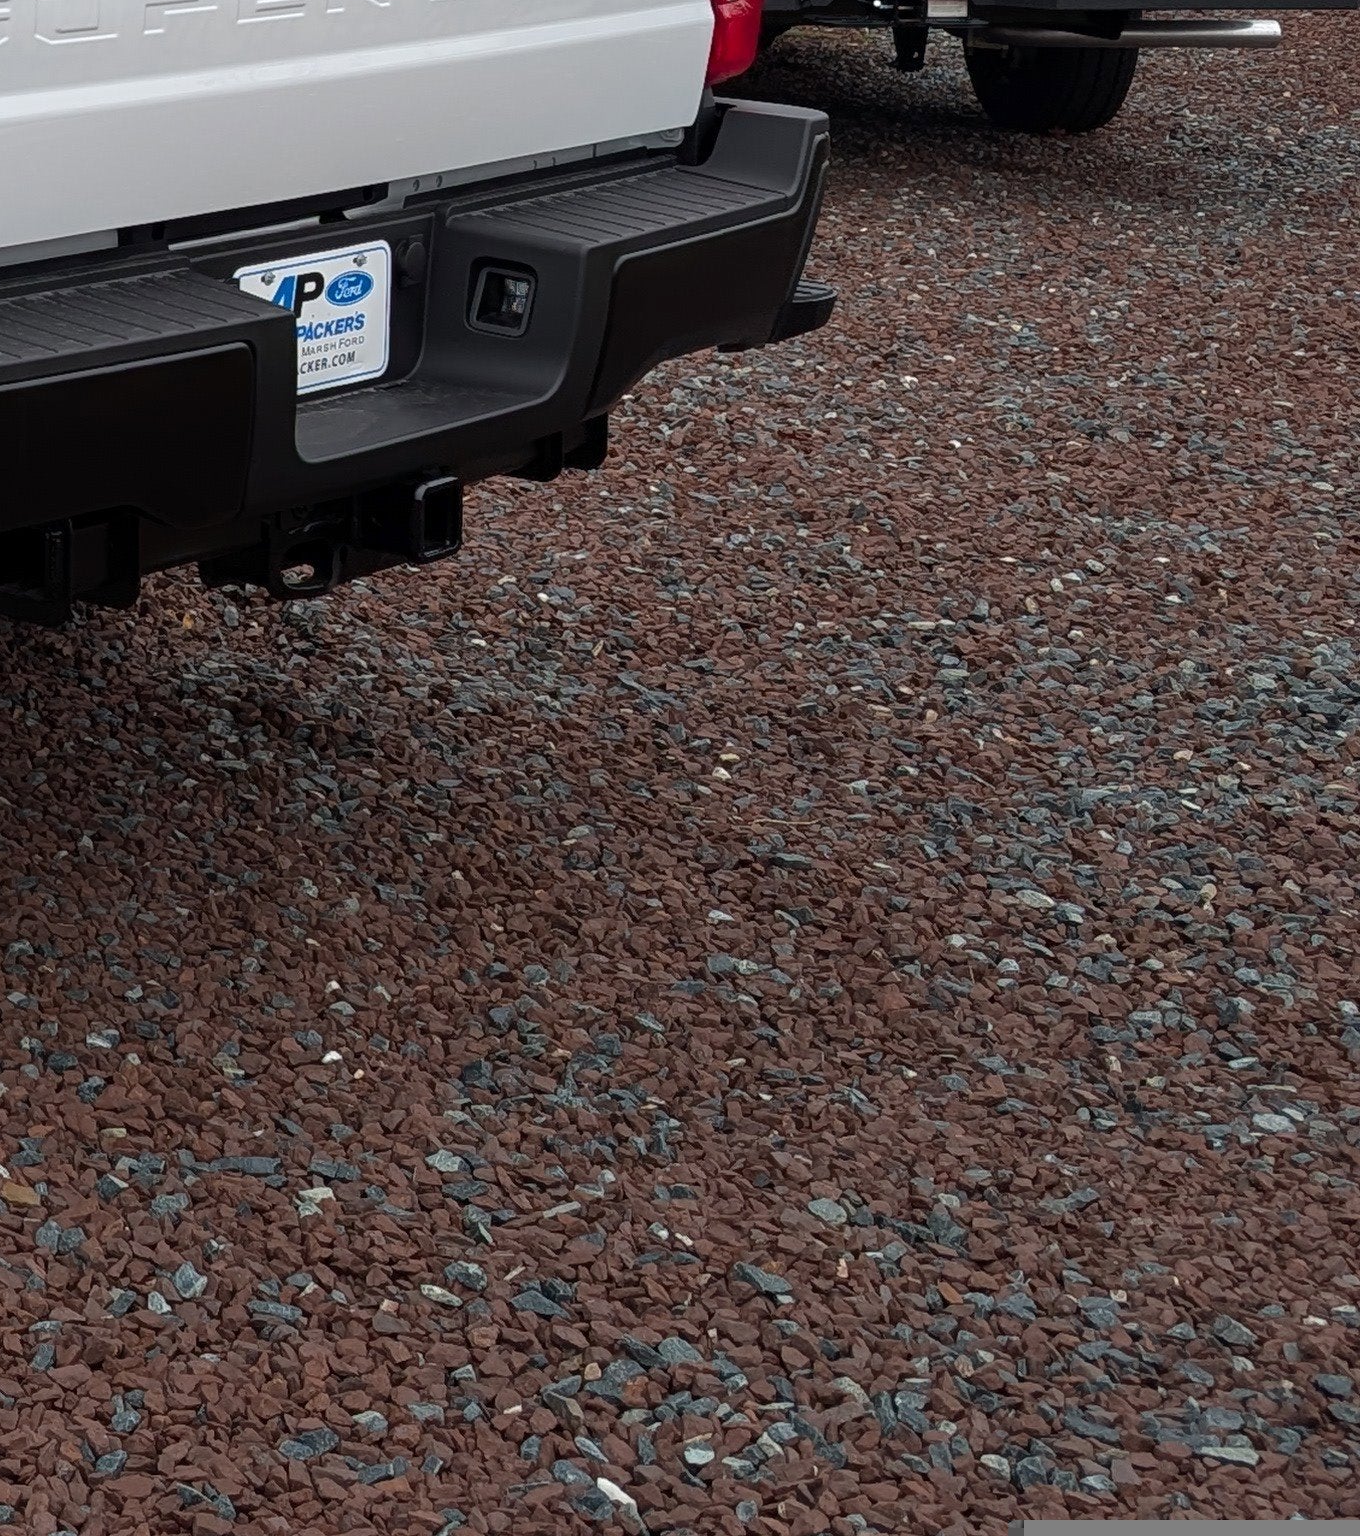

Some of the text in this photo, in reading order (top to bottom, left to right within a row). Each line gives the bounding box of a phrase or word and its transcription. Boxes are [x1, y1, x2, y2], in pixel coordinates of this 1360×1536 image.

[294, 311, 366, 343] PACKER'S
[338, 334, 365, 350] FORD
[298, 350, 356, 375] CKER.COM
